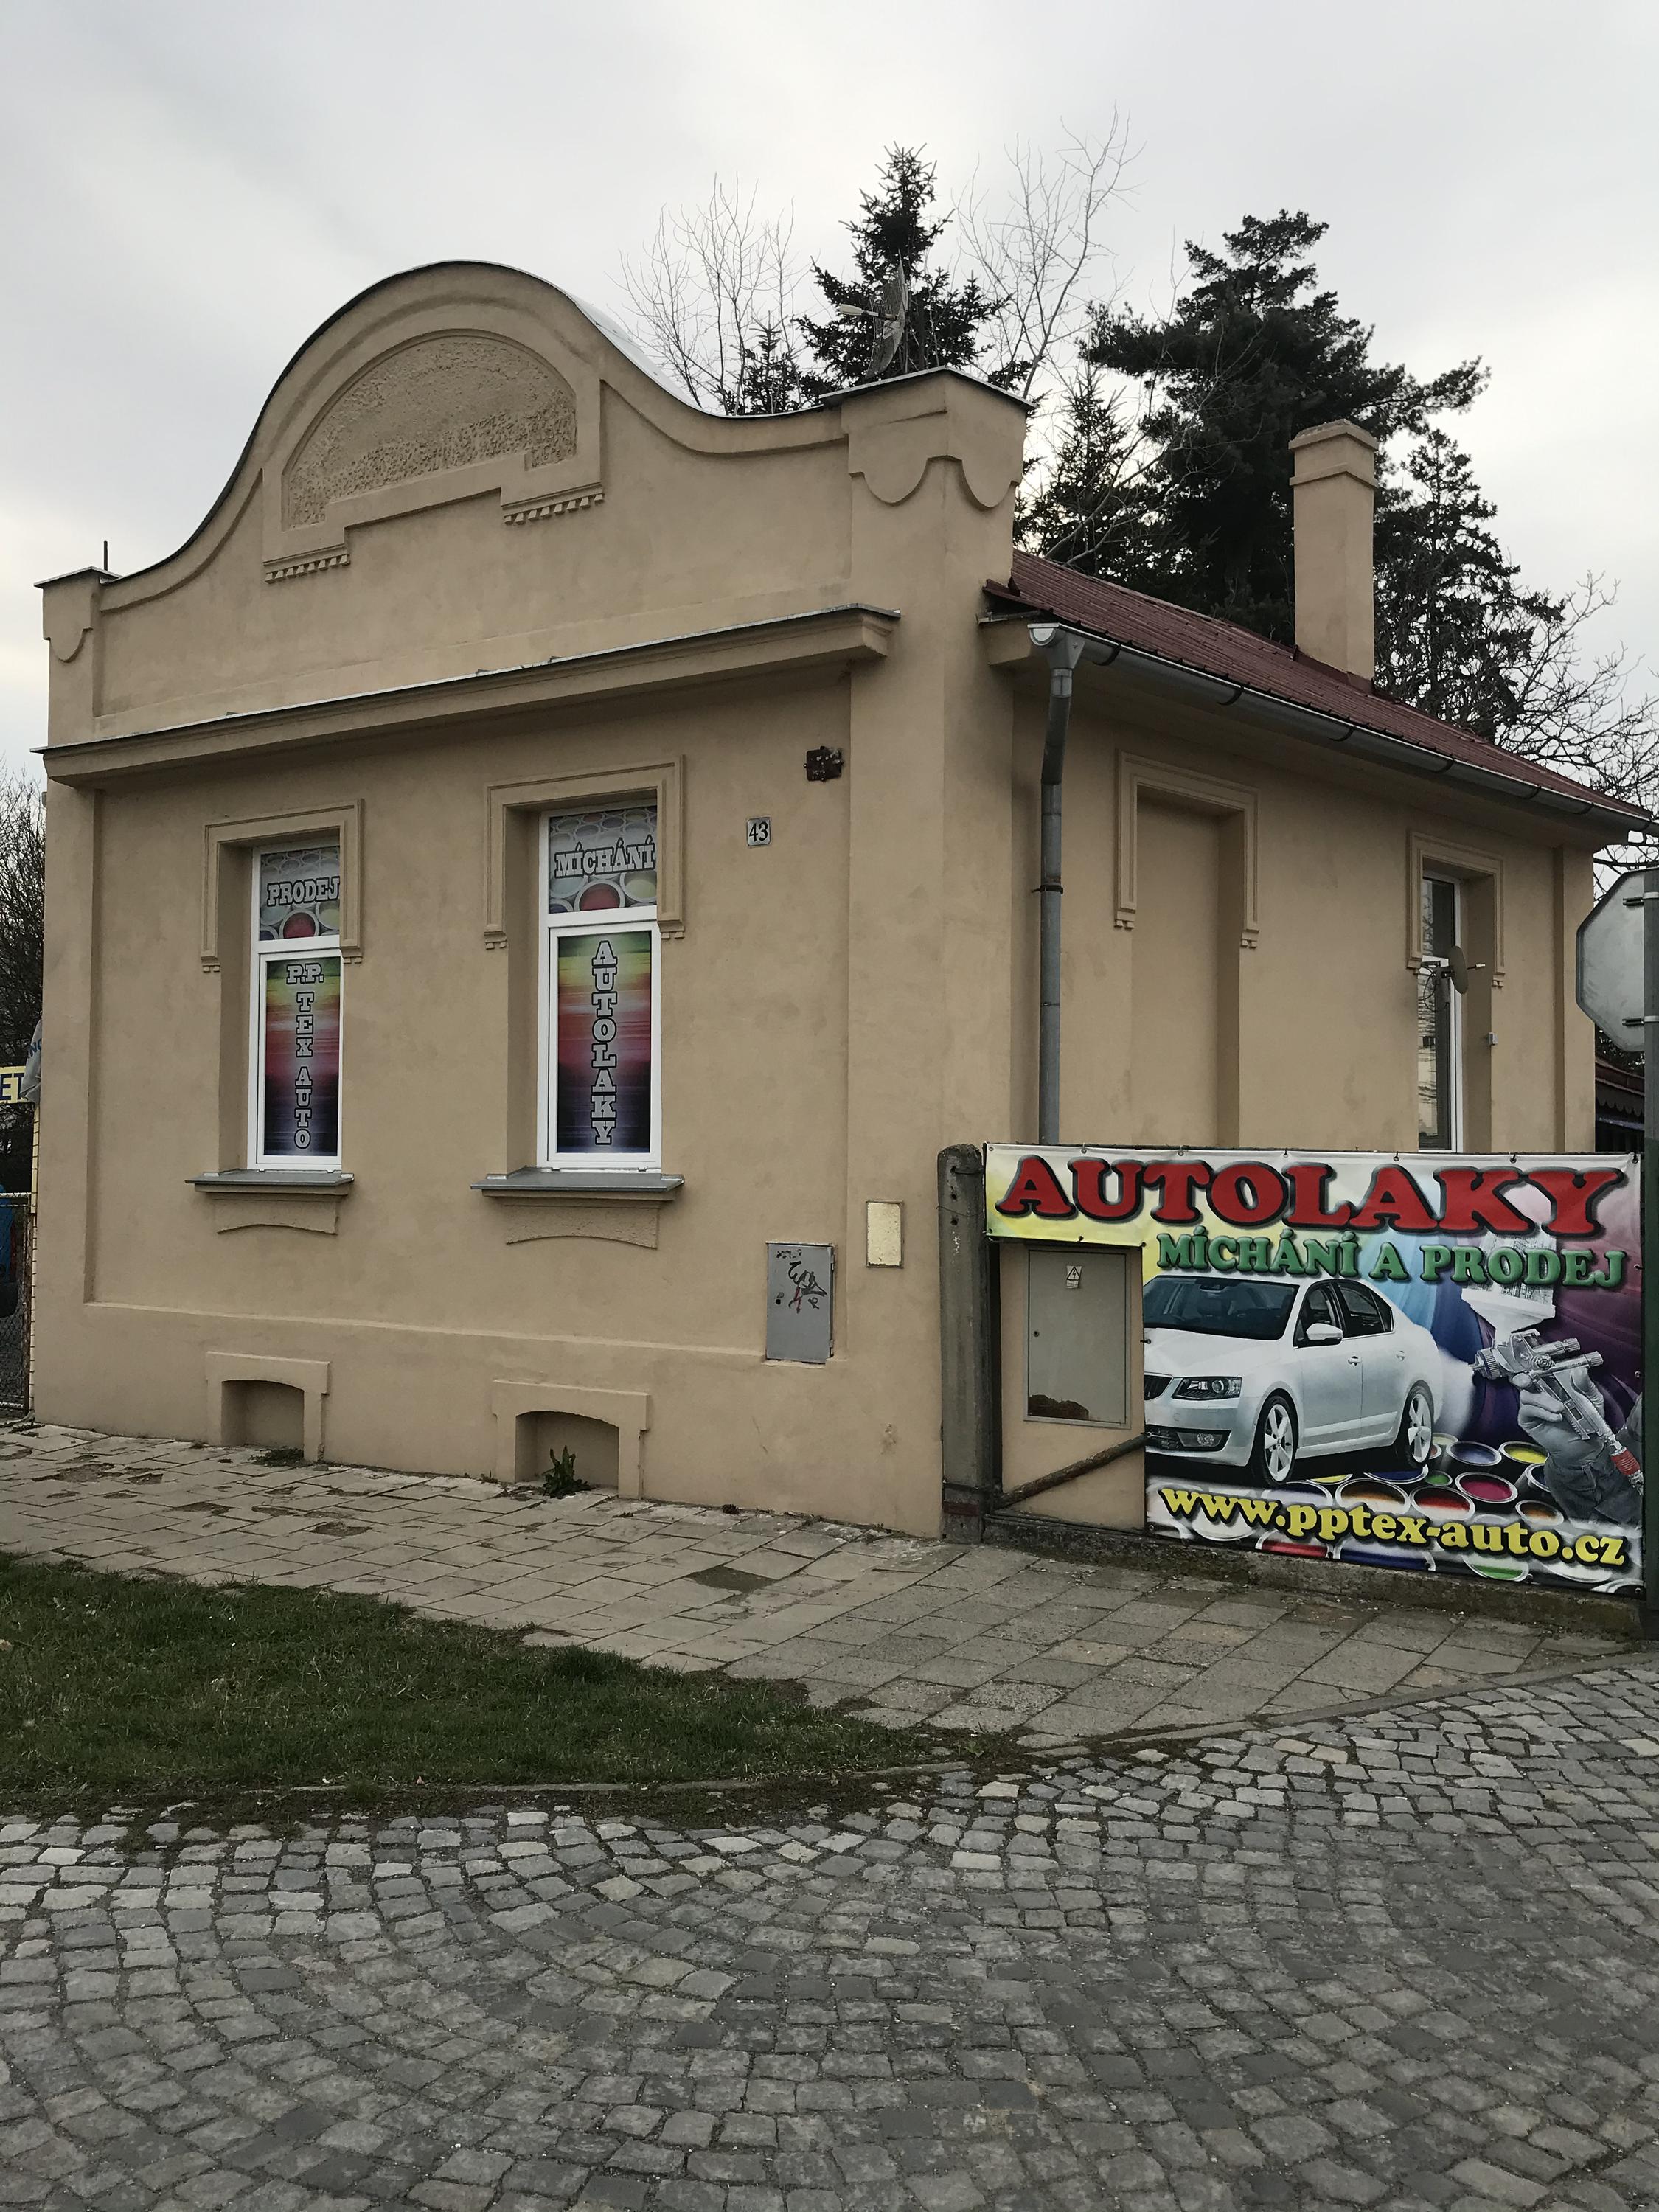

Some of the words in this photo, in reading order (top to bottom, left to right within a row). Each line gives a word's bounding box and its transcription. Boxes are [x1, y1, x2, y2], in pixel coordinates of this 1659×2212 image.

[554, 834, 655, 879] MÍCHÁNÍ
[748, 821, 768, 843] 43
[267, 876, 340, 907] PRODEJ
[286, 962, 324, 984] P.P.
[296, 991, 314, 1057] TEX
[591, 940, 617, 1145] AUTOLAKY
[294, 1066, 311, 1149] AUTO
[995, 1156, 1624, 1237] AUTOLAKY
[1156, 1225, 1360, 1277] MÍCHÁNÍ
[1368, 1242, 1408, 1280] A
[1420, 1245, 1627, 1287] PRODEJ
[1158, 1486, 1630, 1567] www.pptex-auto.cz
